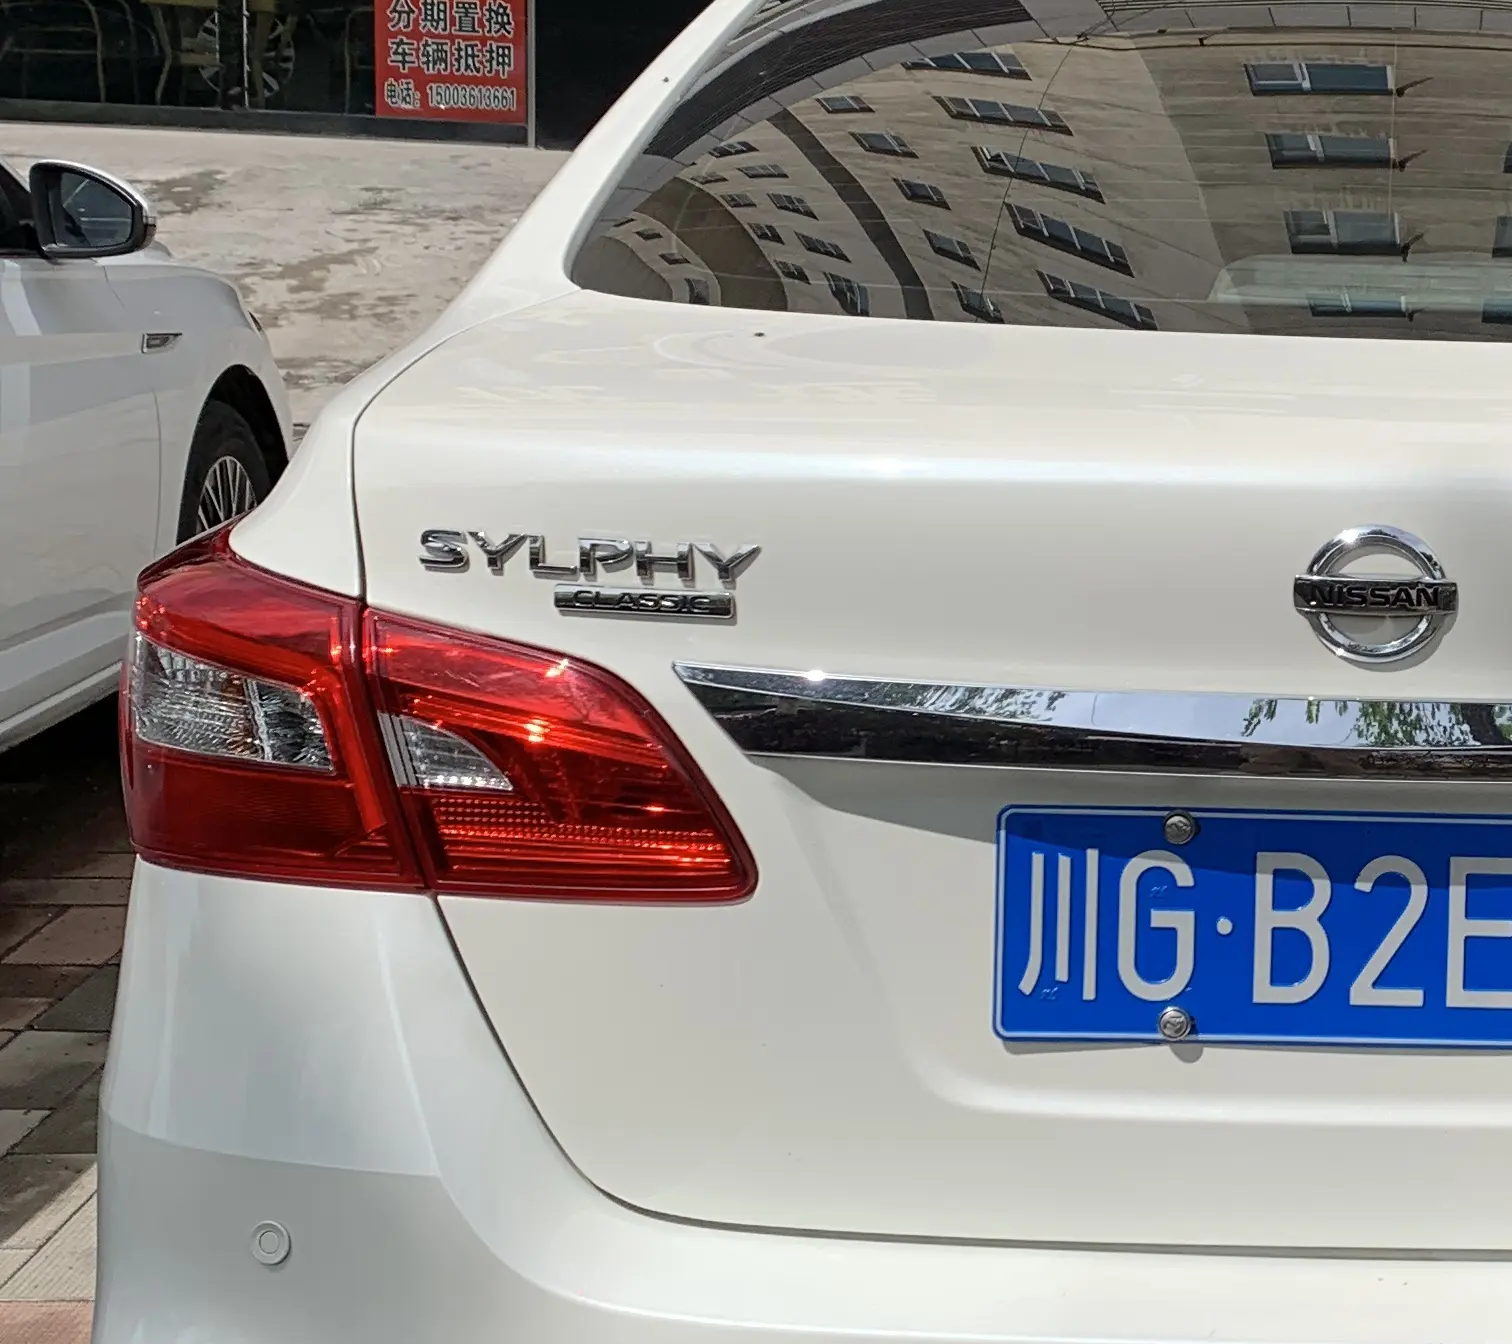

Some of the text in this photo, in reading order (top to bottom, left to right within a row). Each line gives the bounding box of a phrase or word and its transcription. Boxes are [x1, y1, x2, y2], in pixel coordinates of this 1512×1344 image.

[388, 35, 514, 79] 车辆抵押
[426, 83, 517, 111] 15003613661
[419, 528, 763, 582] SYLPHY
[572, 589, 712, 614] CLASSIC
[1310, 584, 1440, 609] NISSAN
